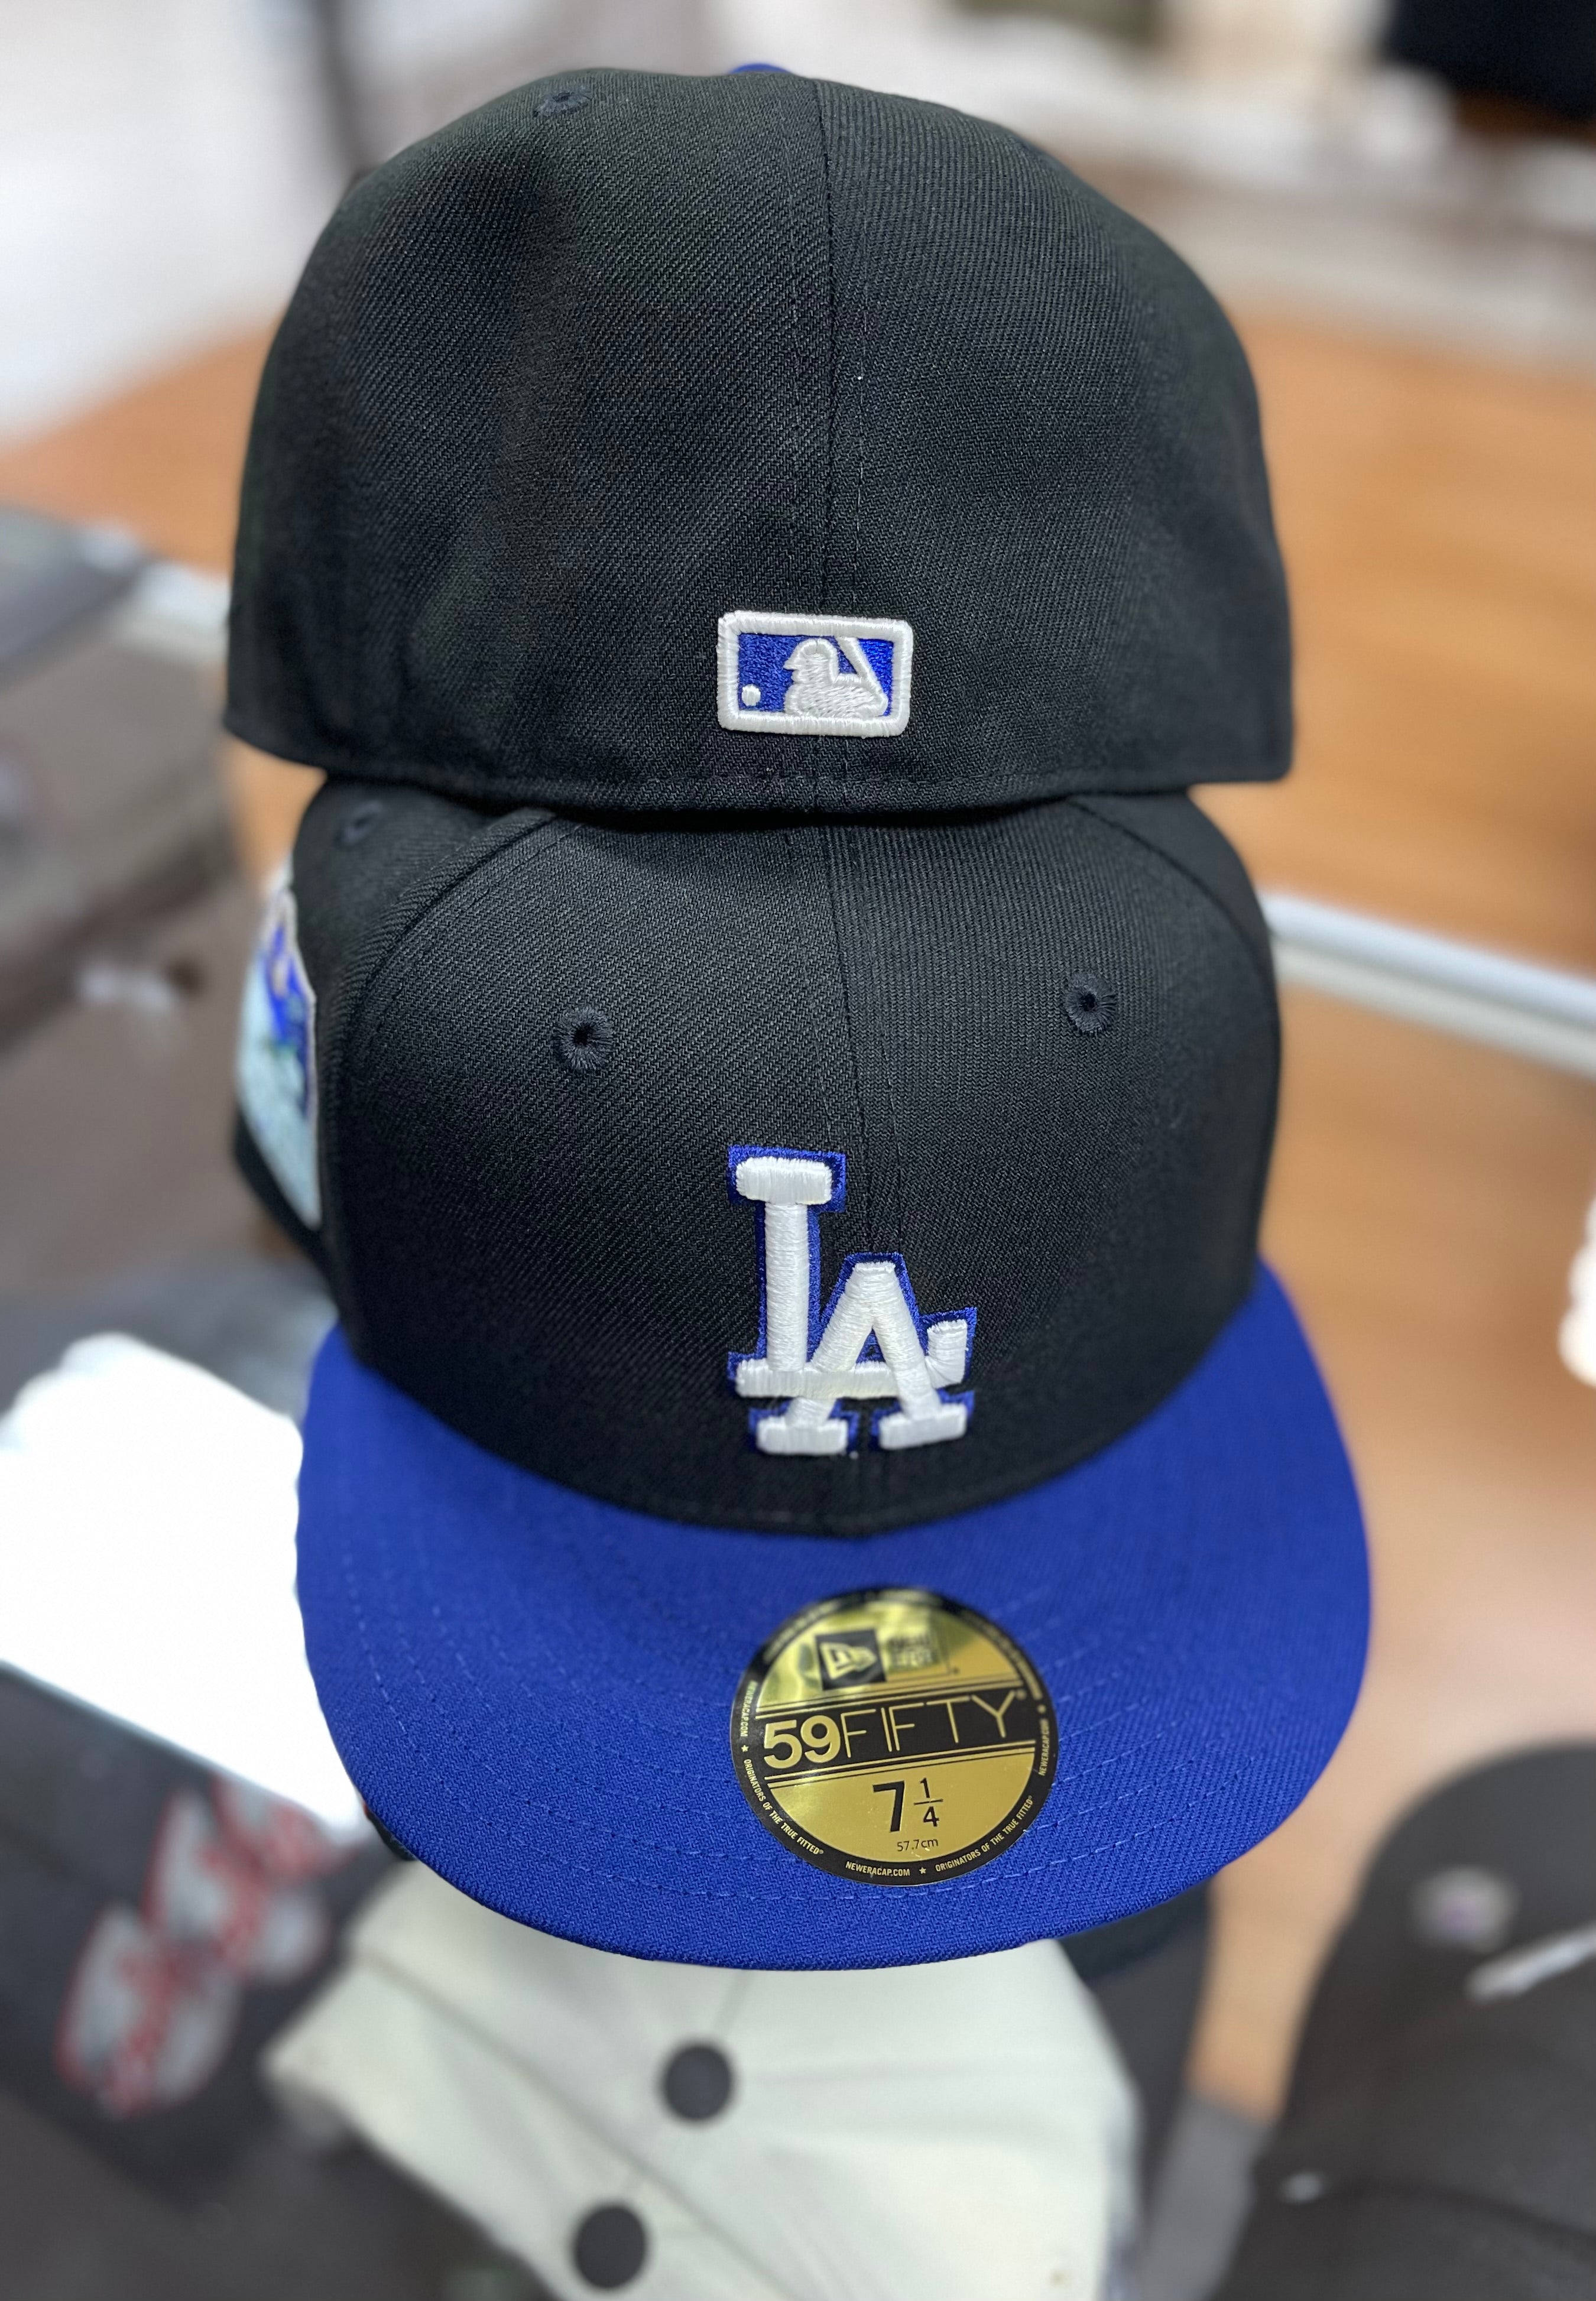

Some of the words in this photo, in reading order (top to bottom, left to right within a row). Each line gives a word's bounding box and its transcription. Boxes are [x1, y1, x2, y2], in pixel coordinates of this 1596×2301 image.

[728, 1147, 975, 1455] LA
[740, 1680, 757, 1737] WERACAP.COM
[744, 1759, 766, 1802] ORIGINATORS
[763, 1802, 773, 1810] OF
[769, 1810, 783, 1824] THE
[780, 1822, 798, 1839] TRUE
[873, 1780, 905, 1832] 7
[845, 1861, 910, 1876] NEWERACAP.COM
[897, 1839, 939, 1852] 57.7cm
[935, 1849, 981, 1872] ORIGINATORS
[981, 1842, 990, 1852] OF
[990, 1833, 1005, 1845] THE
[1002, 1818, 1019, 1835] TRUE
